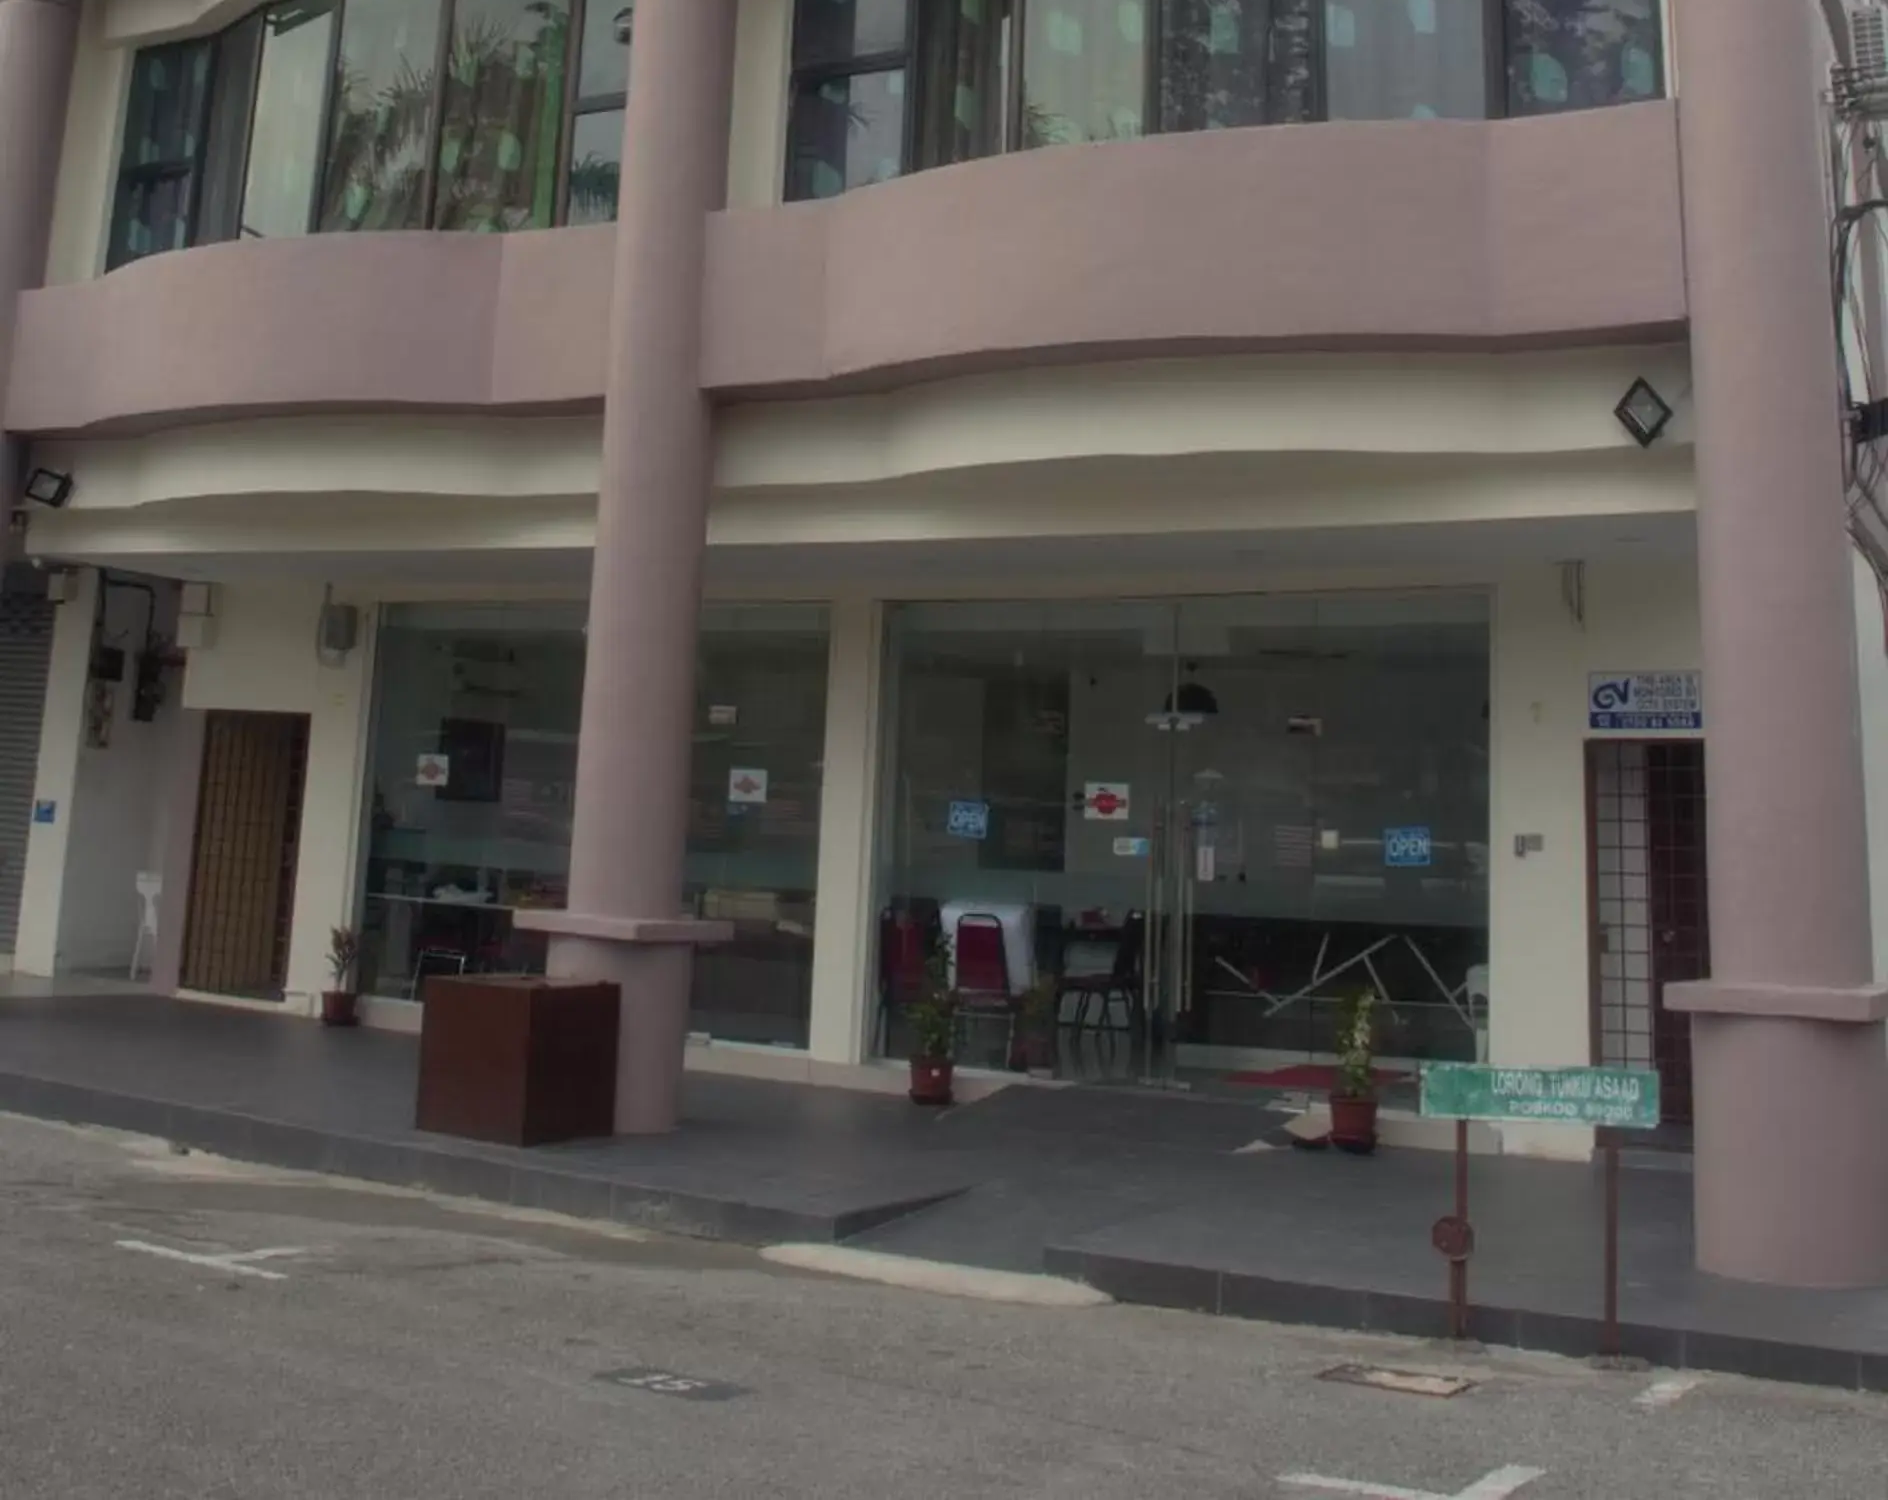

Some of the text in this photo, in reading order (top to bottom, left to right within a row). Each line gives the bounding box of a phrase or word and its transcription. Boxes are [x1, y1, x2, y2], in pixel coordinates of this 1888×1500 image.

[1389, 838, 1430, 858] OPEN
[1490, 1070, 1543, 1097] LORONG
[1593, 1074, 1640, 1101] ASAAD
